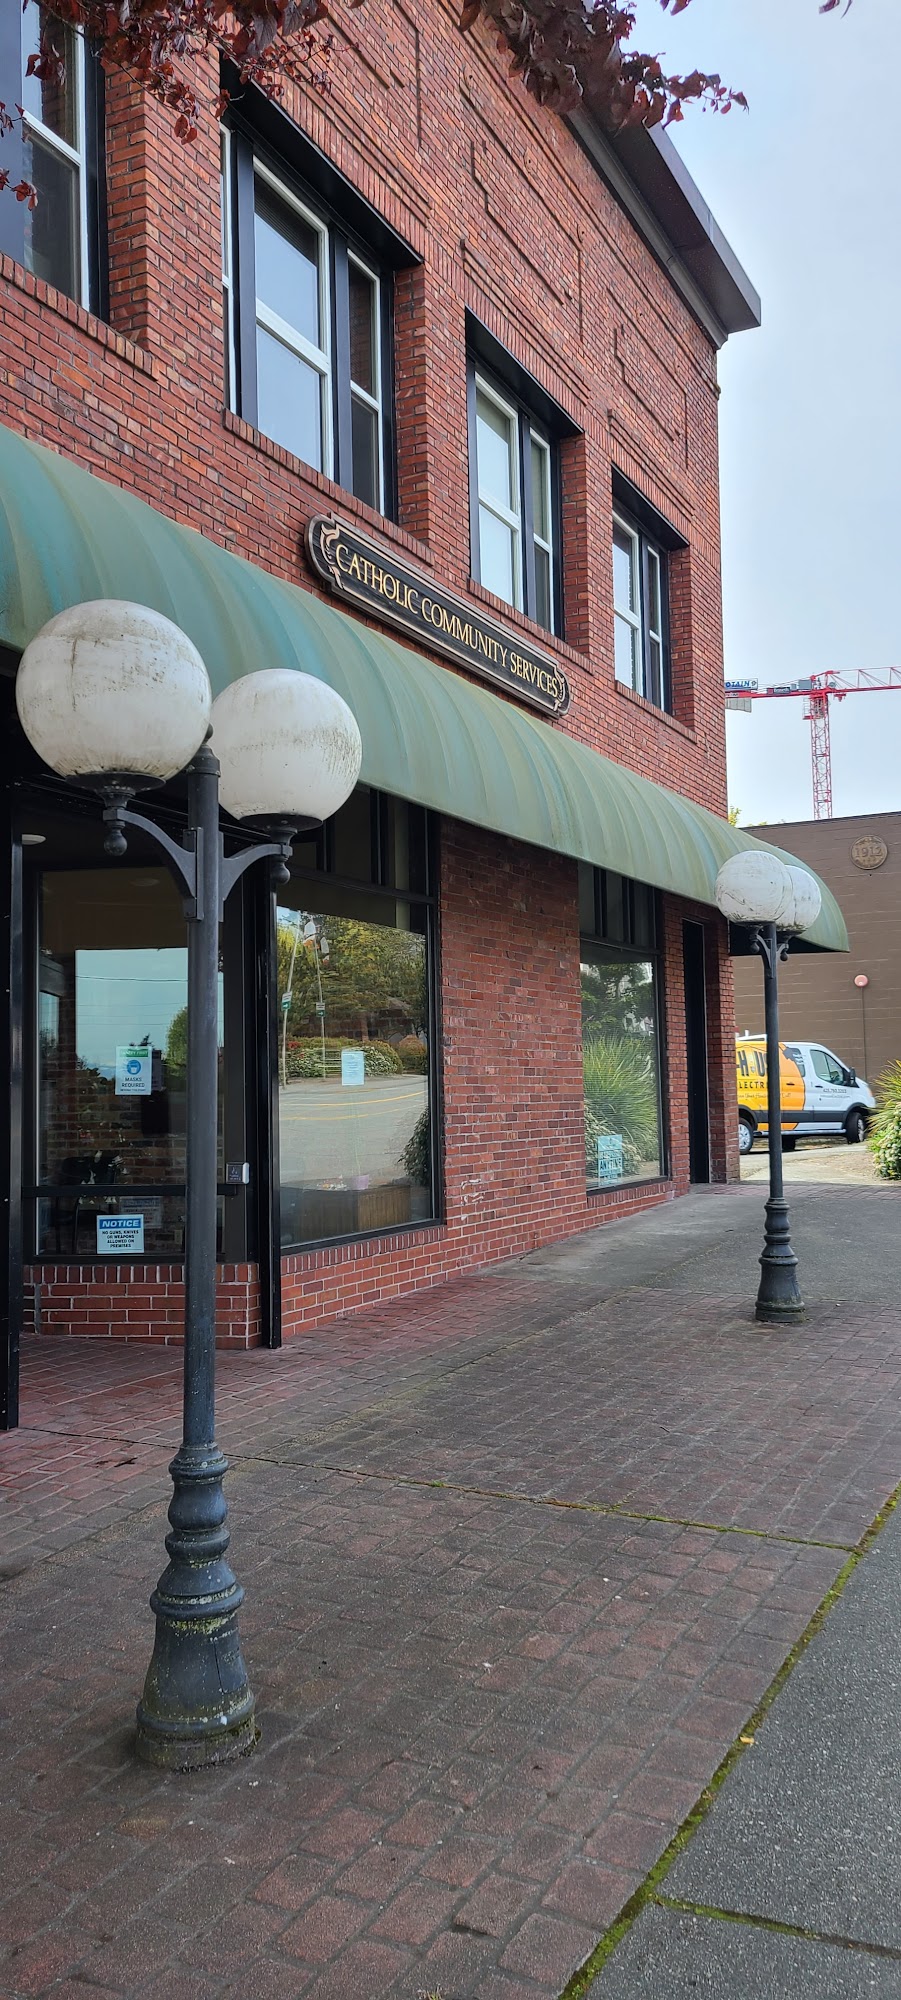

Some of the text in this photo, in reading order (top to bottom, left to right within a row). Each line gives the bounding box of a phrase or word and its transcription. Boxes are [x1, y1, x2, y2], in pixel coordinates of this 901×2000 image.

[335, 543, 558, 698] CATHOLIC COMMUNITY SERVICES
[738, 1081, 765, 1089] LECTR
[102, 1220, 139, 1228] NOTICE
